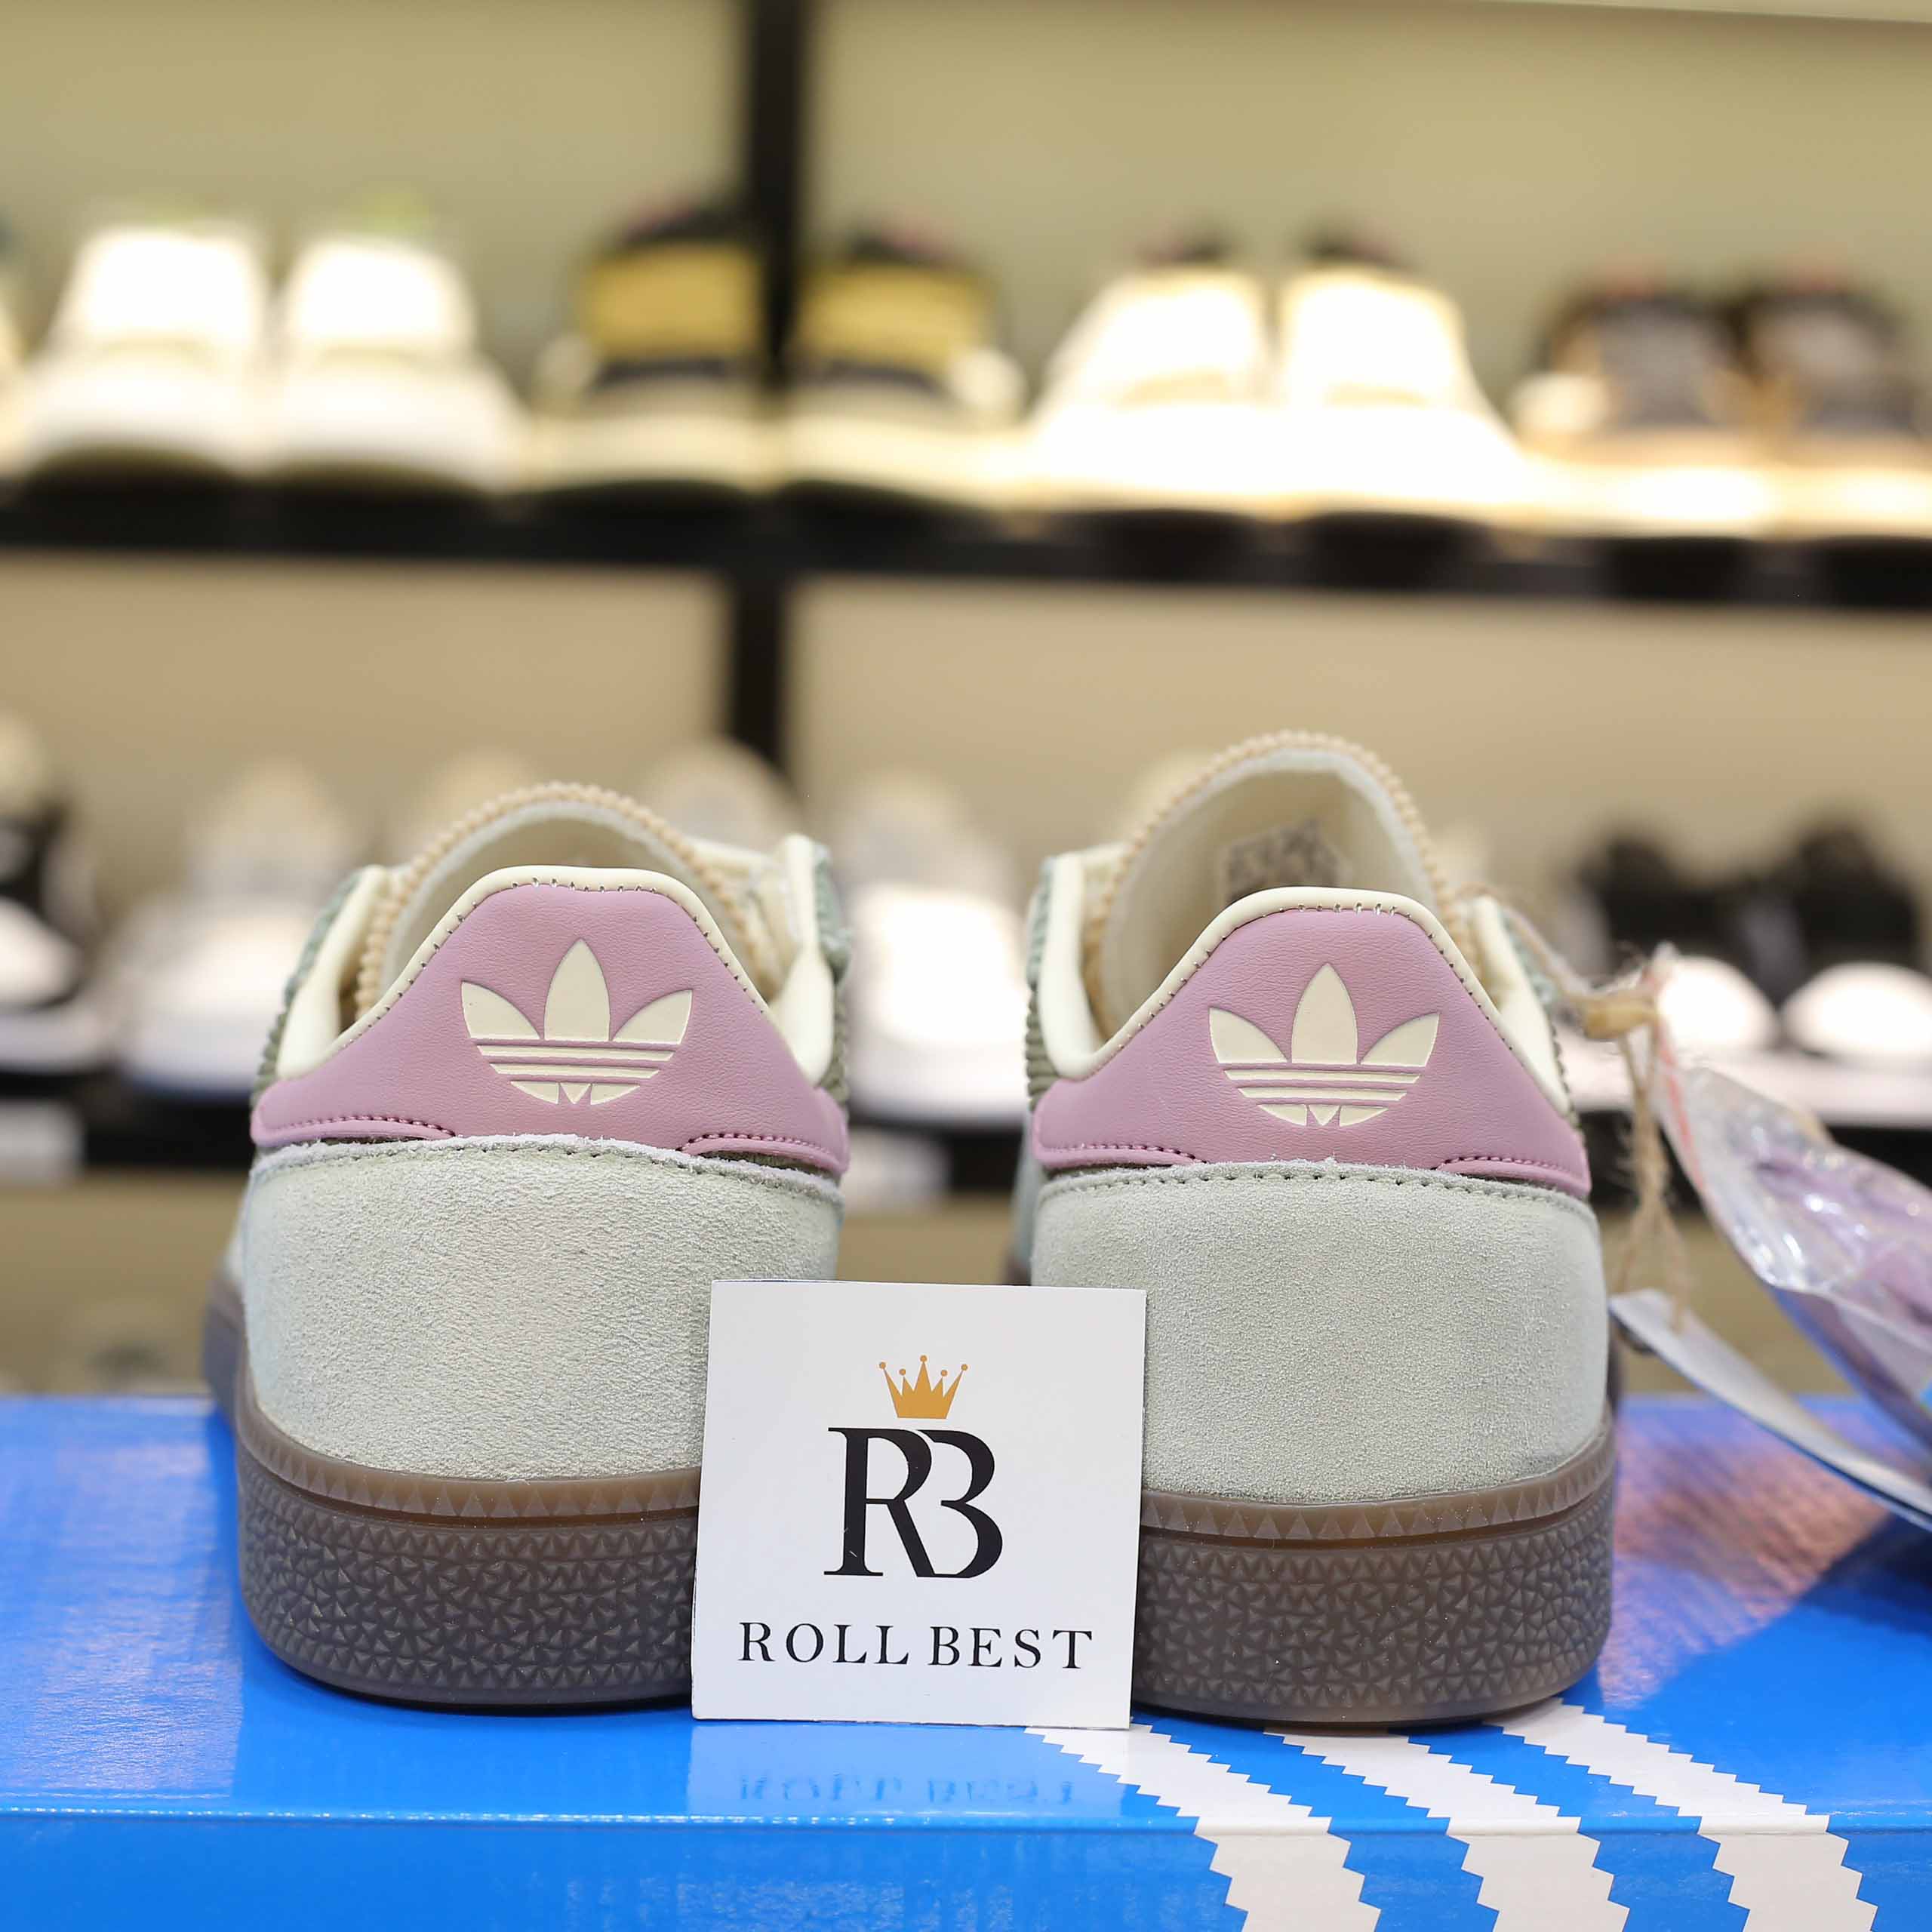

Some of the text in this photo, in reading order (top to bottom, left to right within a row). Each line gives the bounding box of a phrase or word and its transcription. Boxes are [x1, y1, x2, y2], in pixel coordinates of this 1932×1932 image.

[824, 1427, 1003, 1578] RB
[739, 1622, 1093, 1669] ROLL BEST
